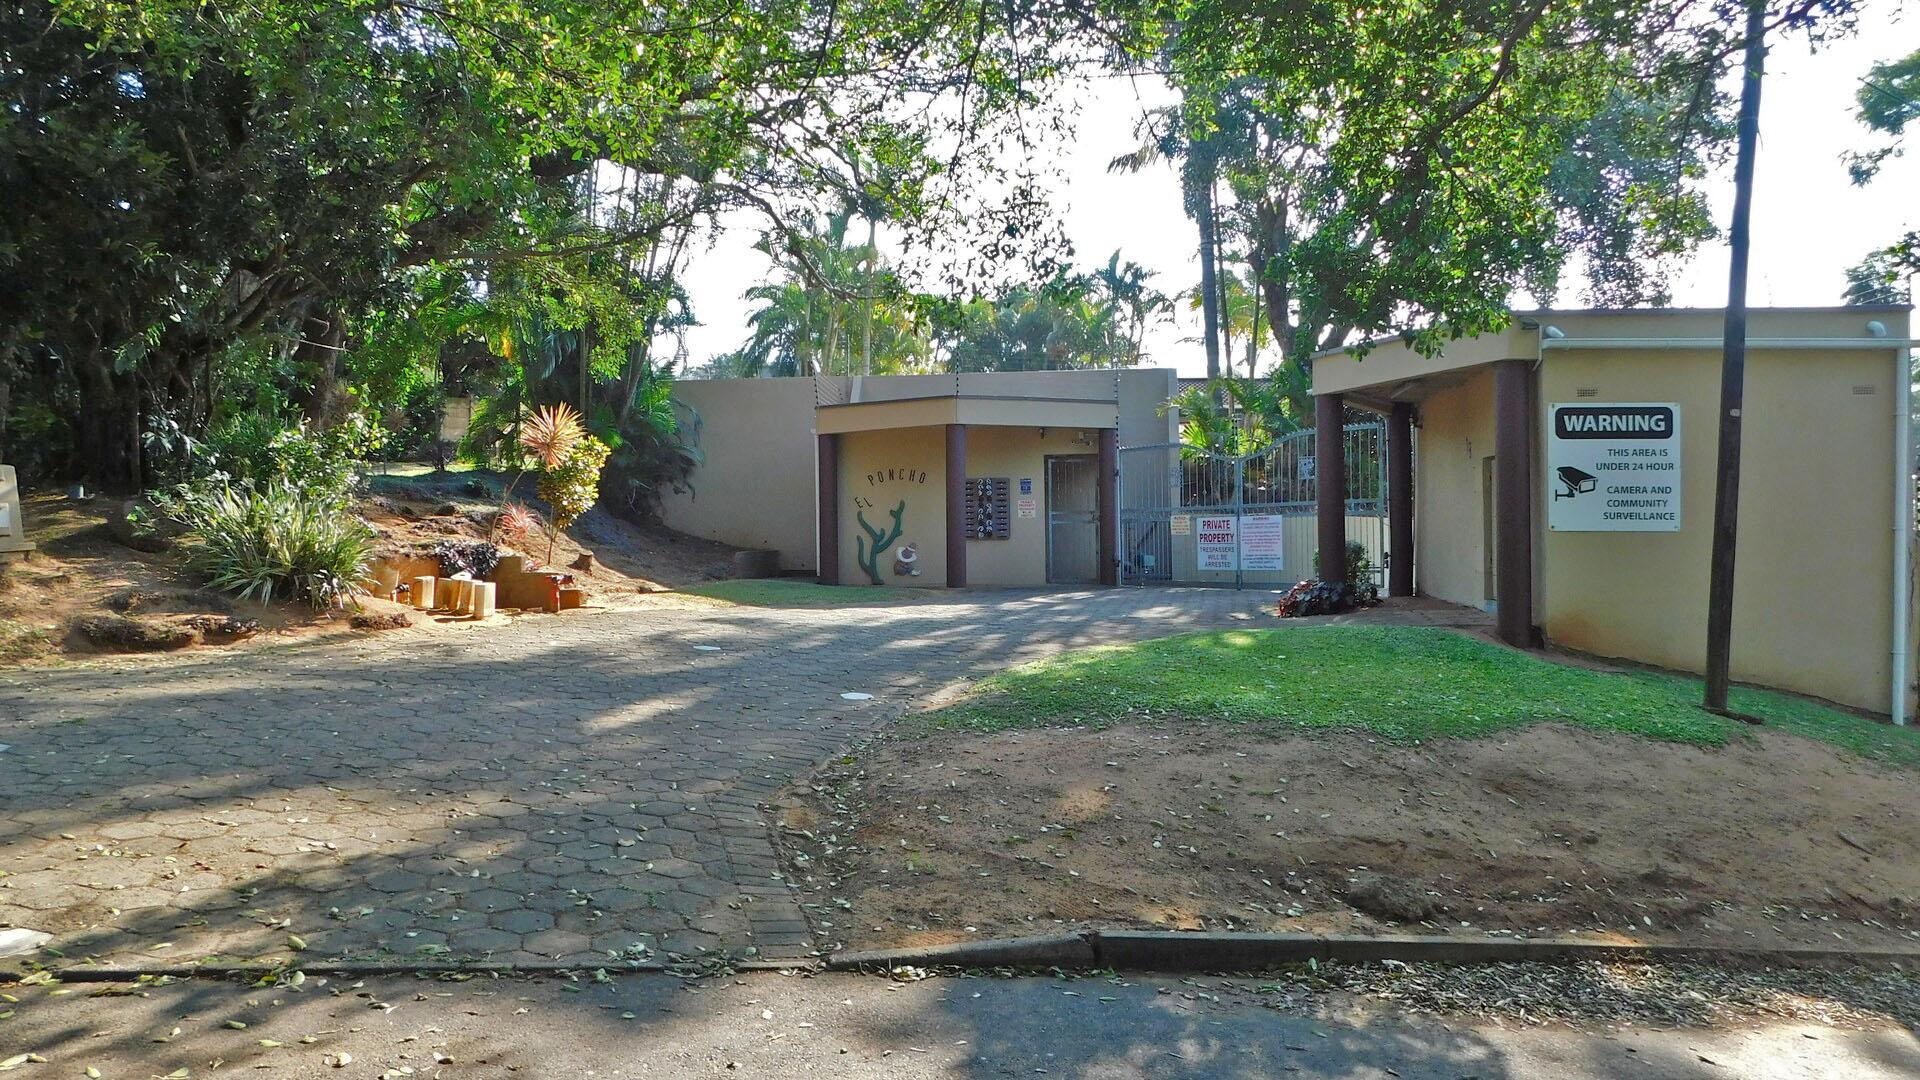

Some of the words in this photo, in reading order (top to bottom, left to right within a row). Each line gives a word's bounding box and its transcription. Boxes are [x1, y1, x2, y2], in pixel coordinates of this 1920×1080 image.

[1563, 414, 1666, 432] WARNING
[1607, 448, 1630, 457] THIS
[1631, 448, 1657, 457] AREA
[1659, 448, 1668, 457] IS
[1595, 462, 1630, 471] UNDER
[1631, 462, 1644, 471] 24
[1645, 462, 1674, 471] HOUR
[854, 496, 873, 509] EL
[867, 468, 927, 486] PONCHO
[1606, 485, 1648, 495] CAMERA
[1650, 485, 1672, 495] AND
[1606, 499, 1668, 508] COMMUNITY
[1602, 512, 1675, 521] SURVEILLANCE
[1202, 519, 1231, 530] PRIVATE
[1199, 533, 1235, 543] PROPERTY
